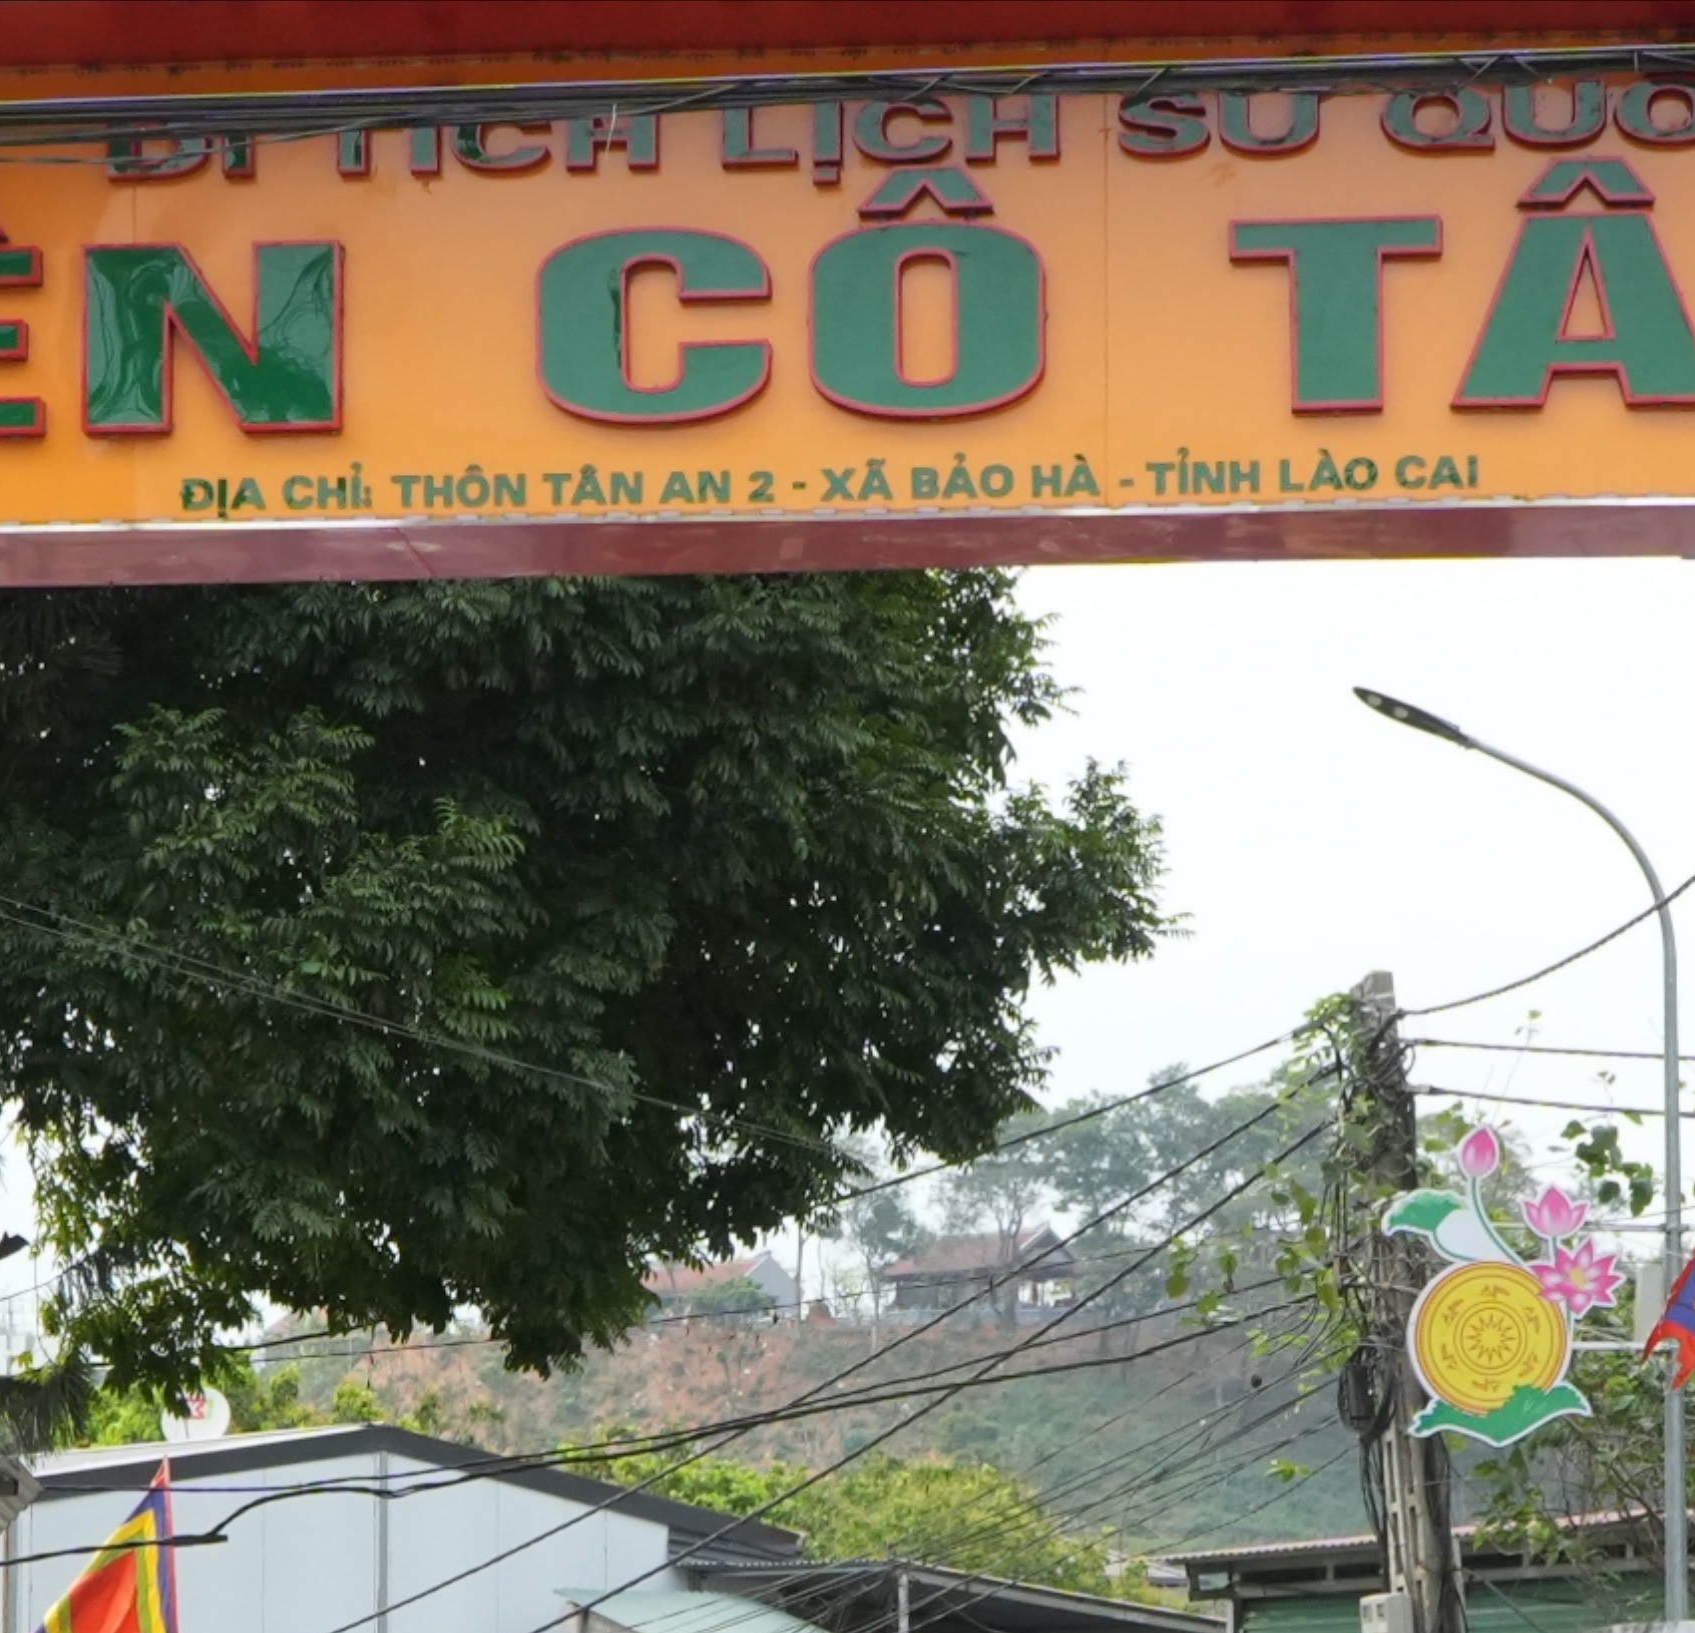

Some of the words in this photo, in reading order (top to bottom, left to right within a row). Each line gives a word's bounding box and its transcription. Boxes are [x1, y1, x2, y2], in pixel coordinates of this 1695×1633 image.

[535, 166, 1046, 422] CÔ
[180, 476, 267, 519] ĐỊA
[391, 465, 526, 508] THÔN
[544, 465, 643, 505] TÂN
[659, 471, 731, 504] AN
[749, 472, 775, 502] 2
[821, 458, 893, 500] XÃ
[911, 453, 1015, 499] BẢO
[1032, 453, 1099, 497] HÀ
[1146, 447, 1259, 495] TỈNH
[1280, 447, 1377, 492] LÀO
[1395, 455, 1478, 489] CAI
